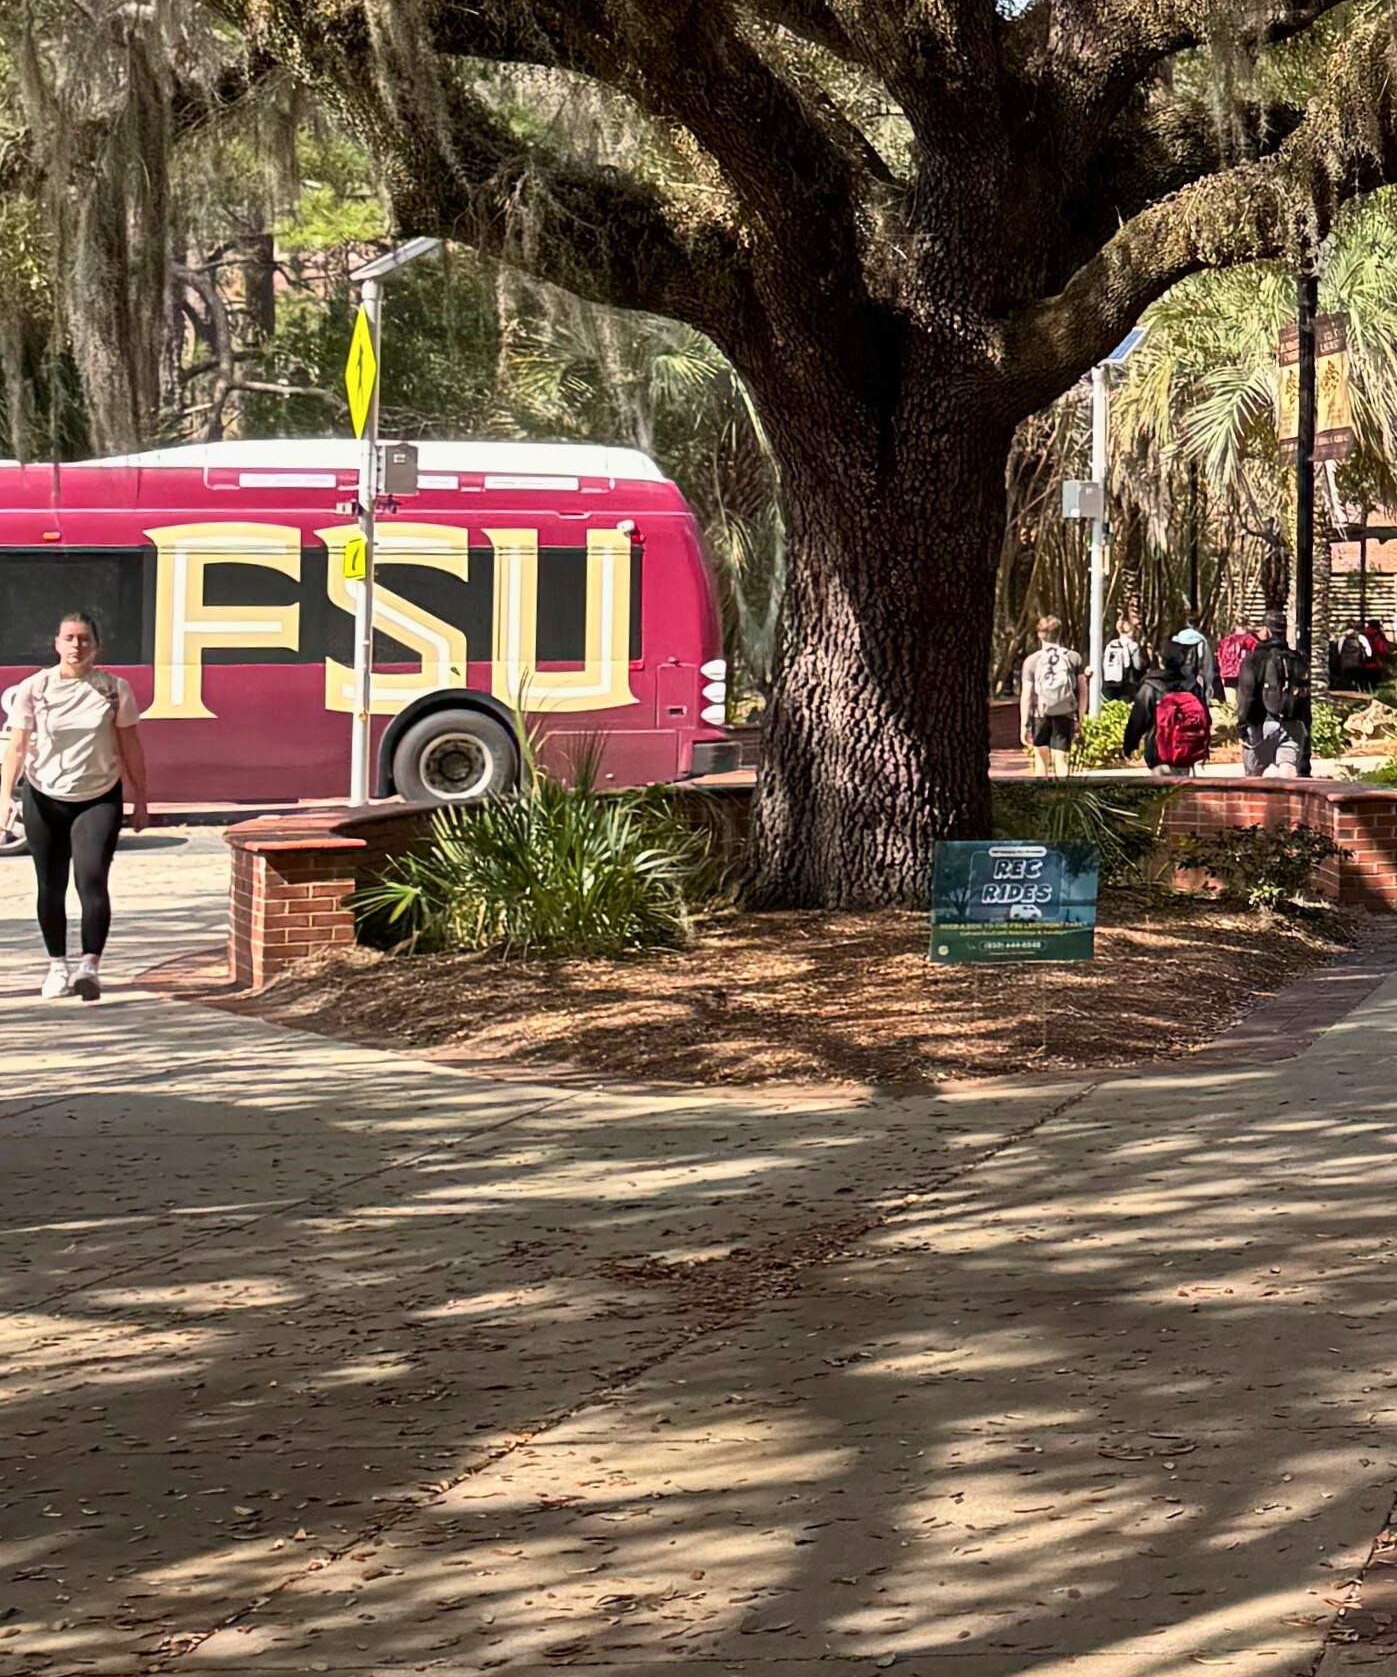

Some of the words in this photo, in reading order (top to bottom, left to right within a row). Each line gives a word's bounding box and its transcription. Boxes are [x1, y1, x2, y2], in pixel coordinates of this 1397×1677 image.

[139, 522, 640, 719] FSU
[993, 859, 1044, 880] REC
[981, 884, 1053, 904] RIDES
